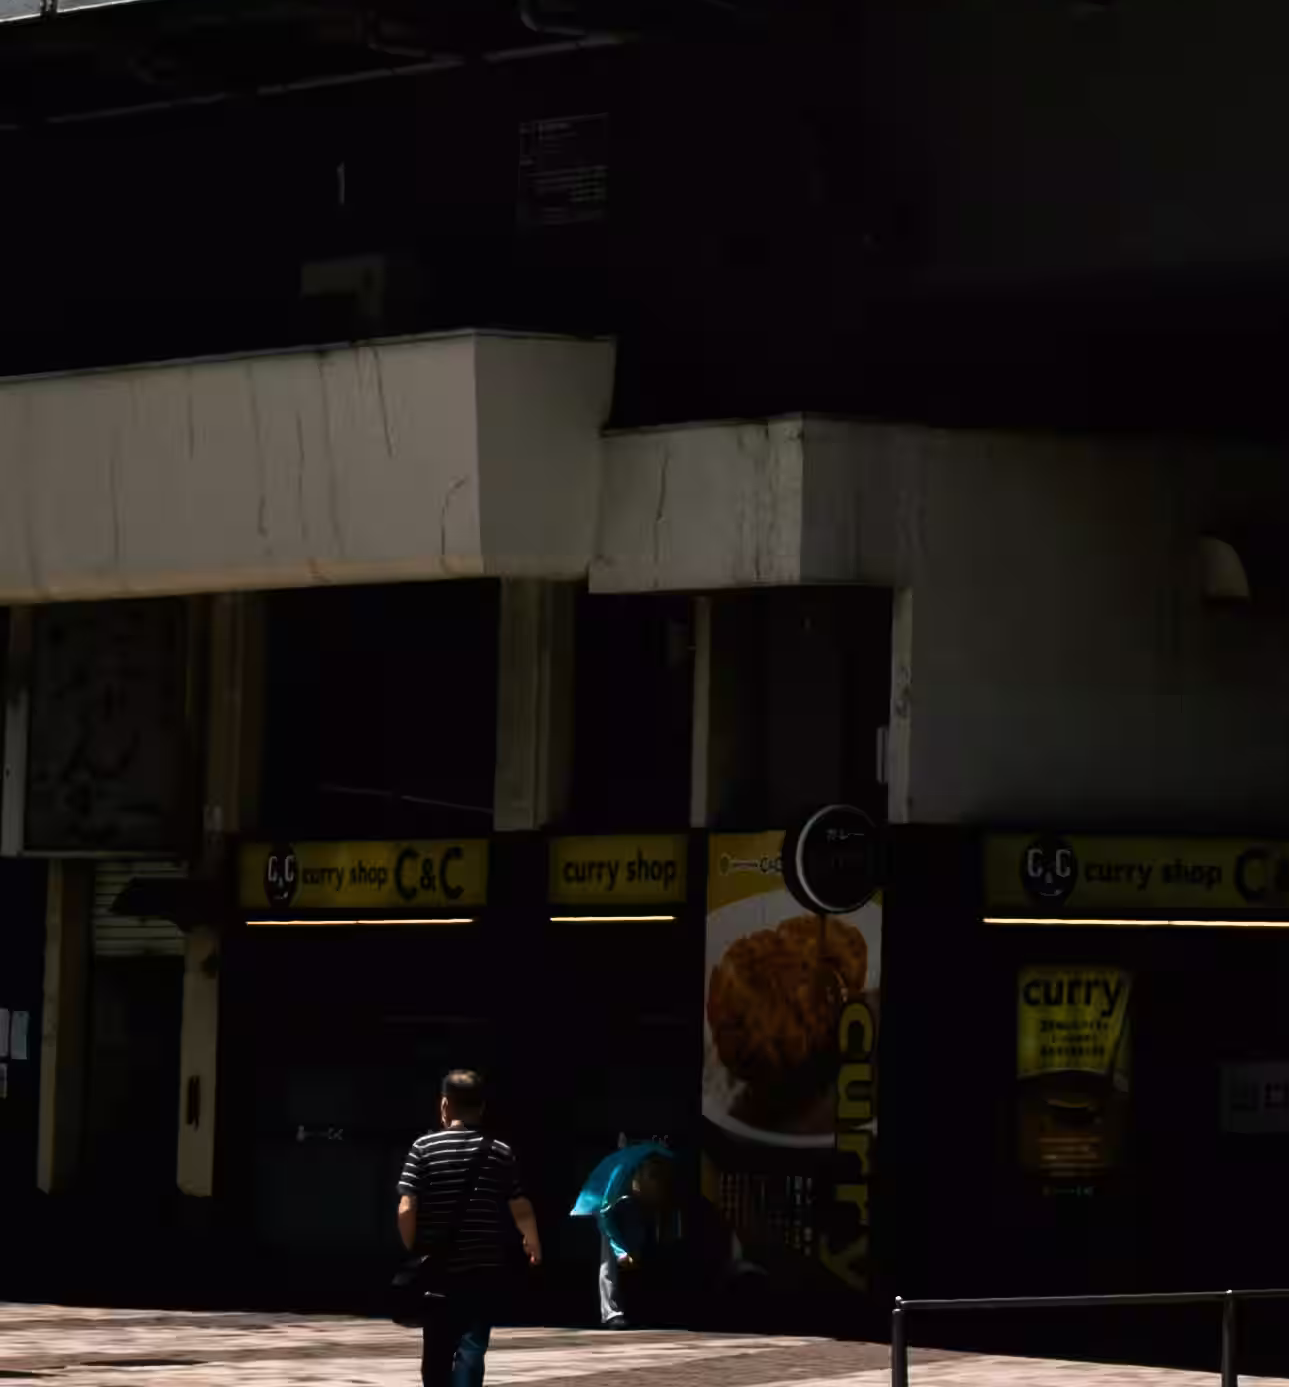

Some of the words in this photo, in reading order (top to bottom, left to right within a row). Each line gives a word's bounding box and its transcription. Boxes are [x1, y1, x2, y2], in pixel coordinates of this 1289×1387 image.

[302, 867, 345, 892] curry
[350, 861, 388, 889] shop
[395, 847, 464, 901] C&C
[563, 858, 621, 892] curry
[627, 851, 677, 890] shop
[1085, 862, 1153, 891] curry
[1162, 856, 1223, 885] shop
[1023, 977, 1121, 1017] curry
